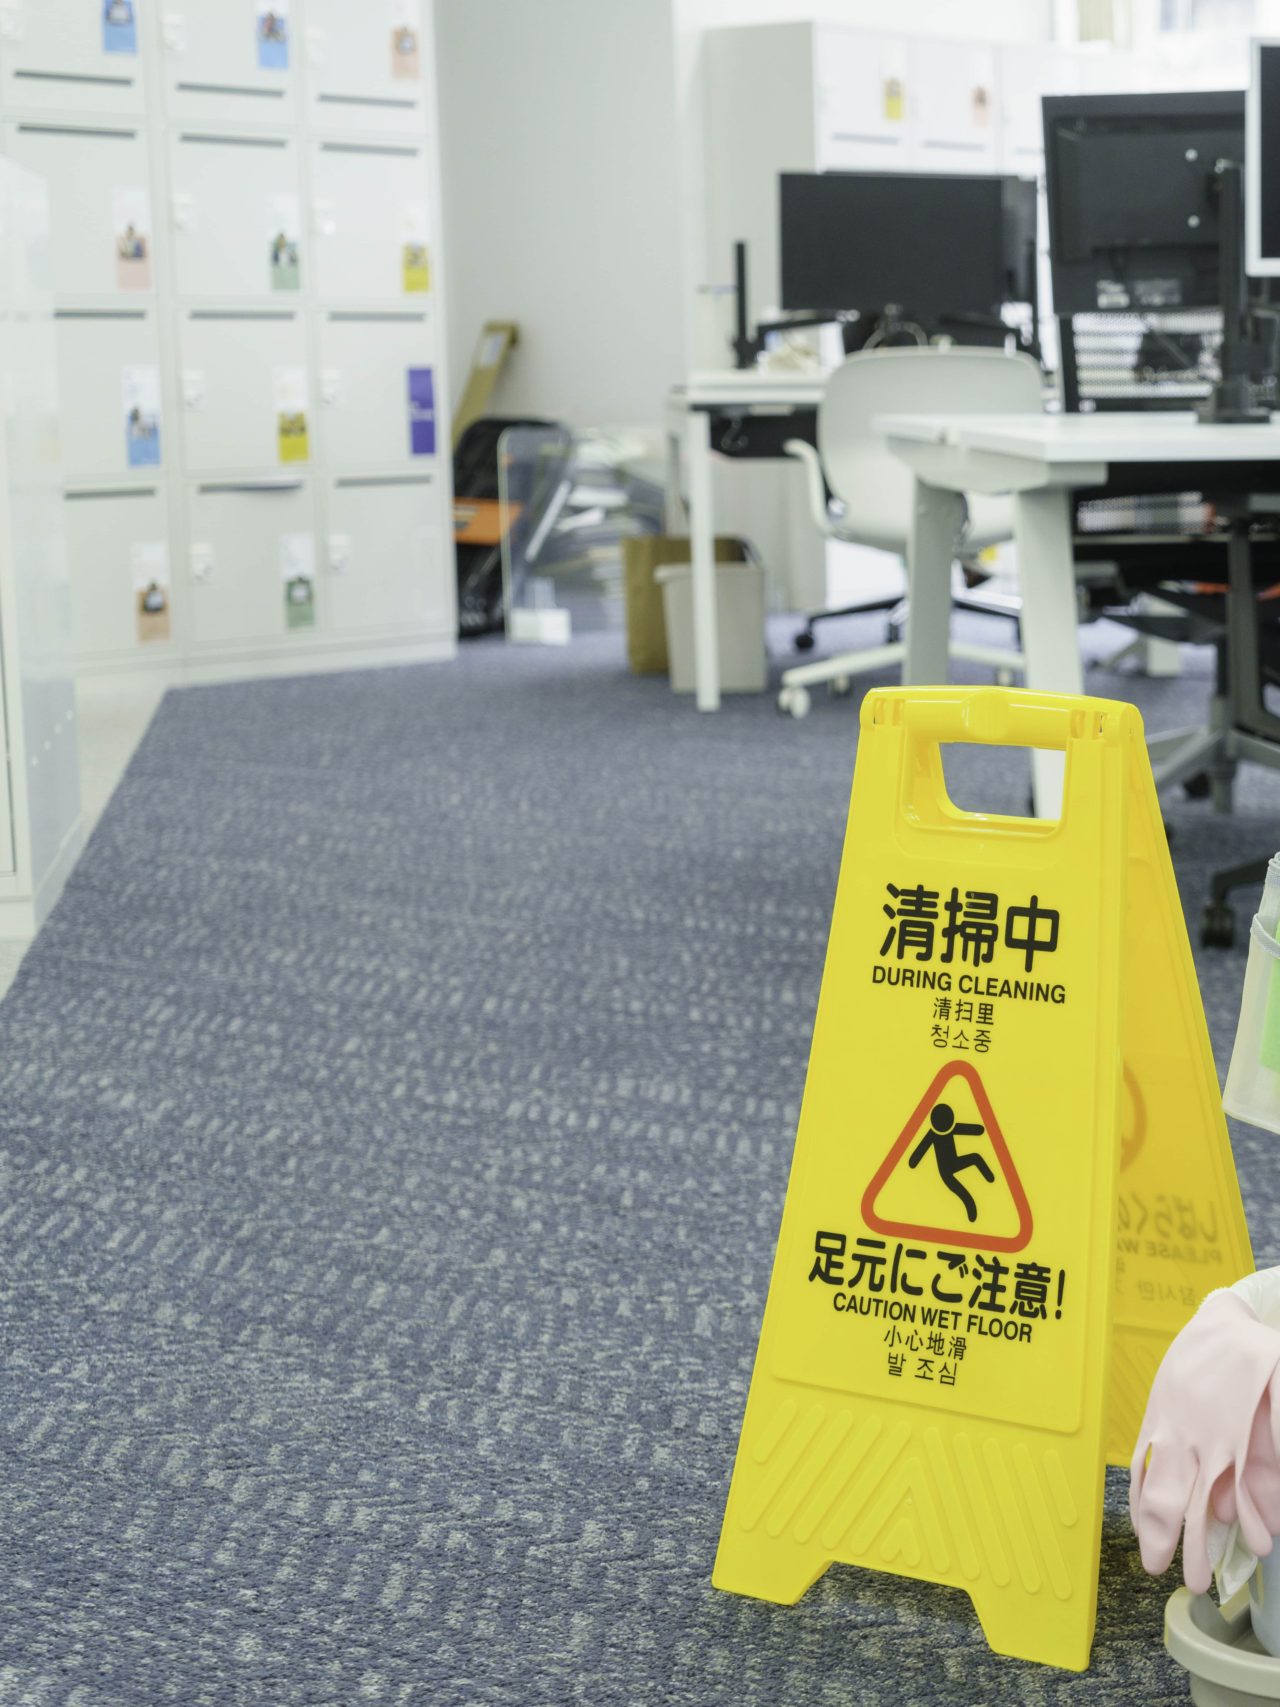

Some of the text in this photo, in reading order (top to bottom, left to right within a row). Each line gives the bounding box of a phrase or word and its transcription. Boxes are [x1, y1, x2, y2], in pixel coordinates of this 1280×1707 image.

[879, 882, 1060, 973] 清掃中
[872, 965, 1067, 1005] DURING CLEANING
[932, 996, 995, 1026] 清扫里
[930, 1023, 992, 1054] 청소중
[807, 1230, 1067, 1321] 足元にご注意!
[832, 1291, 1033, 1344] CAUTION WET FLOOR
[883, 1324, 967, 1361] 小心地滑
[886, 1351, 959, 1387] 발 조심
